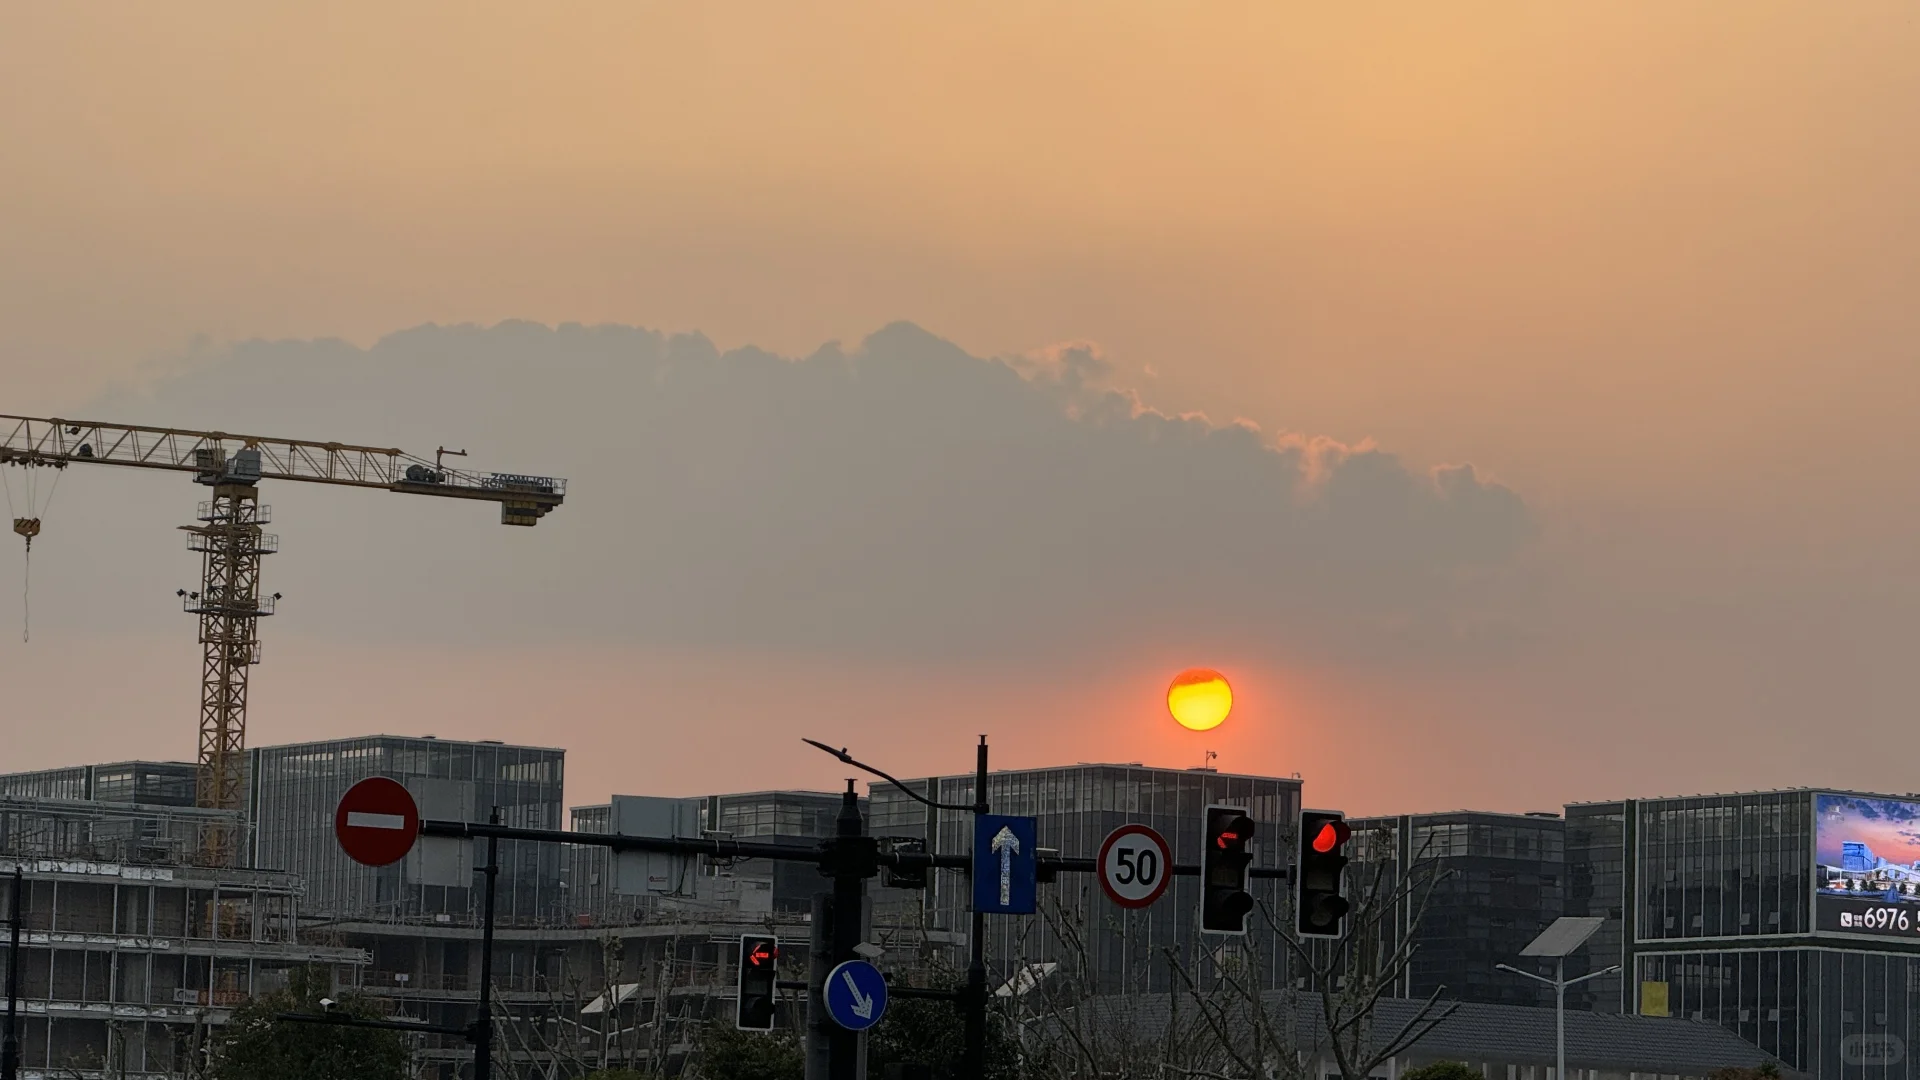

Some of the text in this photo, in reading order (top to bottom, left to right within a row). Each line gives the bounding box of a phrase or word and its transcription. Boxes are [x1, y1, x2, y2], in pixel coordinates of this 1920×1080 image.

[491, 473, 553, 487] ZOOMLION
[1115, 848, 1157, 885] 50
[1864, 907, 1909, 931] 6976
